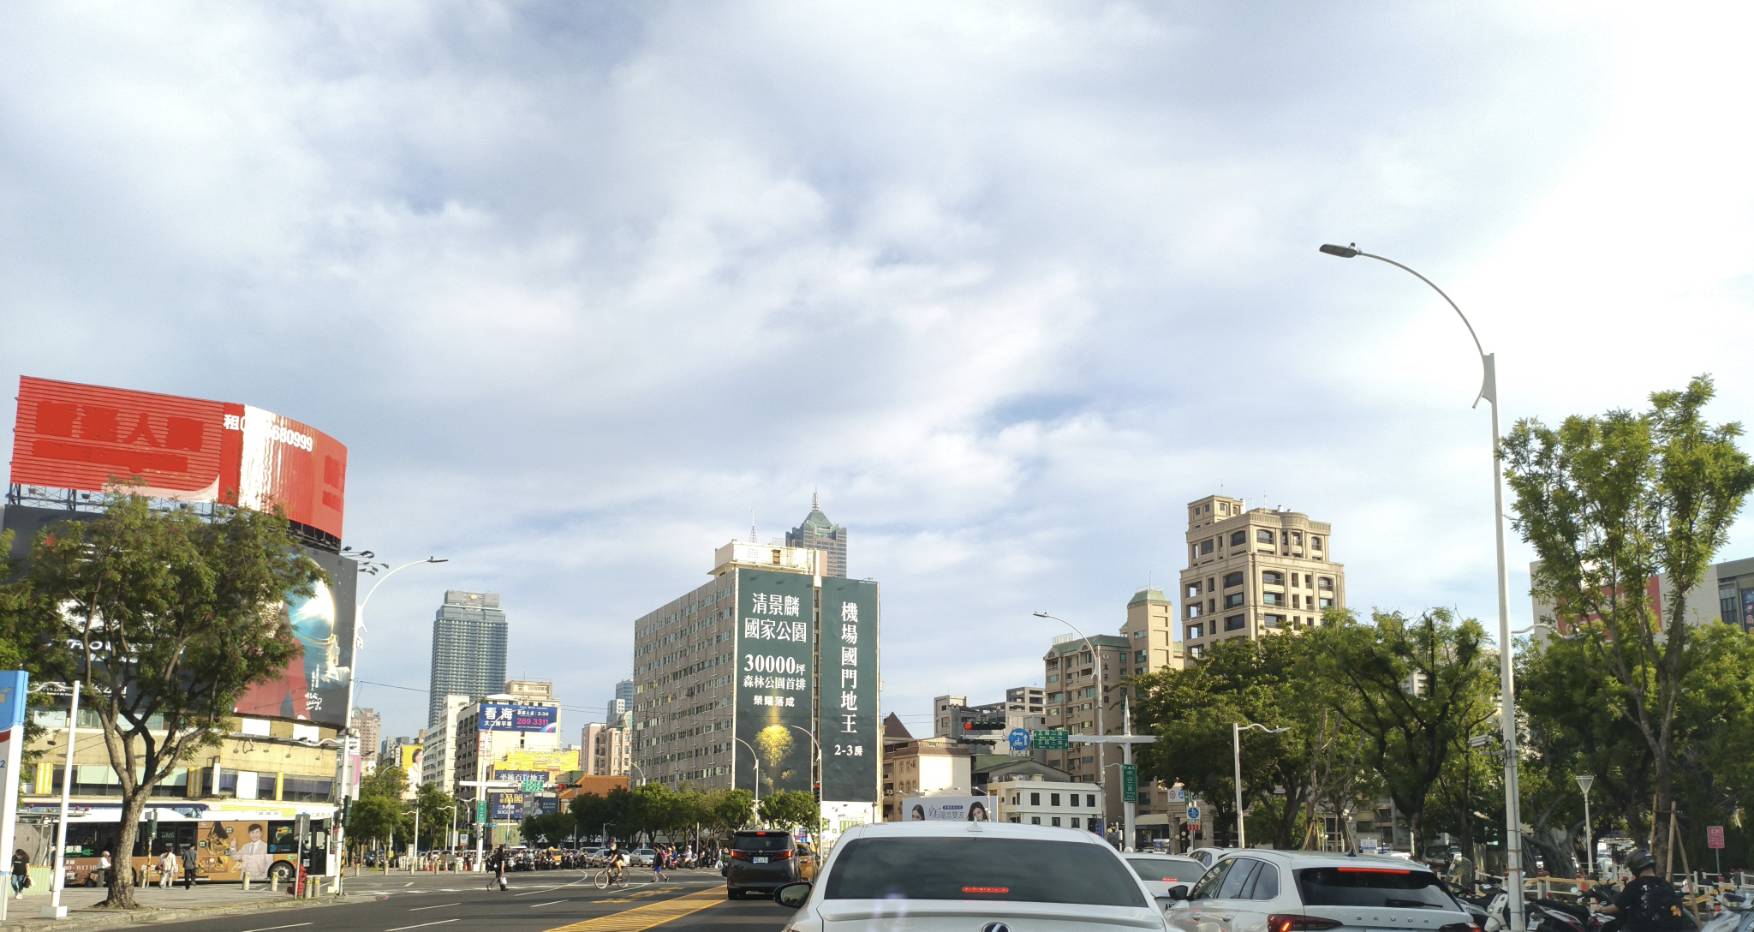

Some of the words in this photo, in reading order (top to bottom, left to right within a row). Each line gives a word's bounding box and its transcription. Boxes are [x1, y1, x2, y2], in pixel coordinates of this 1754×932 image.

[752, 592, 800, 617] 清景麟
[744, 617, 807, 642] 國家公園
[743, 654, 806, 676] 30000坪
[840, 601, 858, 733] 機場國門地王
[743, 675, 806, 691] 森林公園首排
